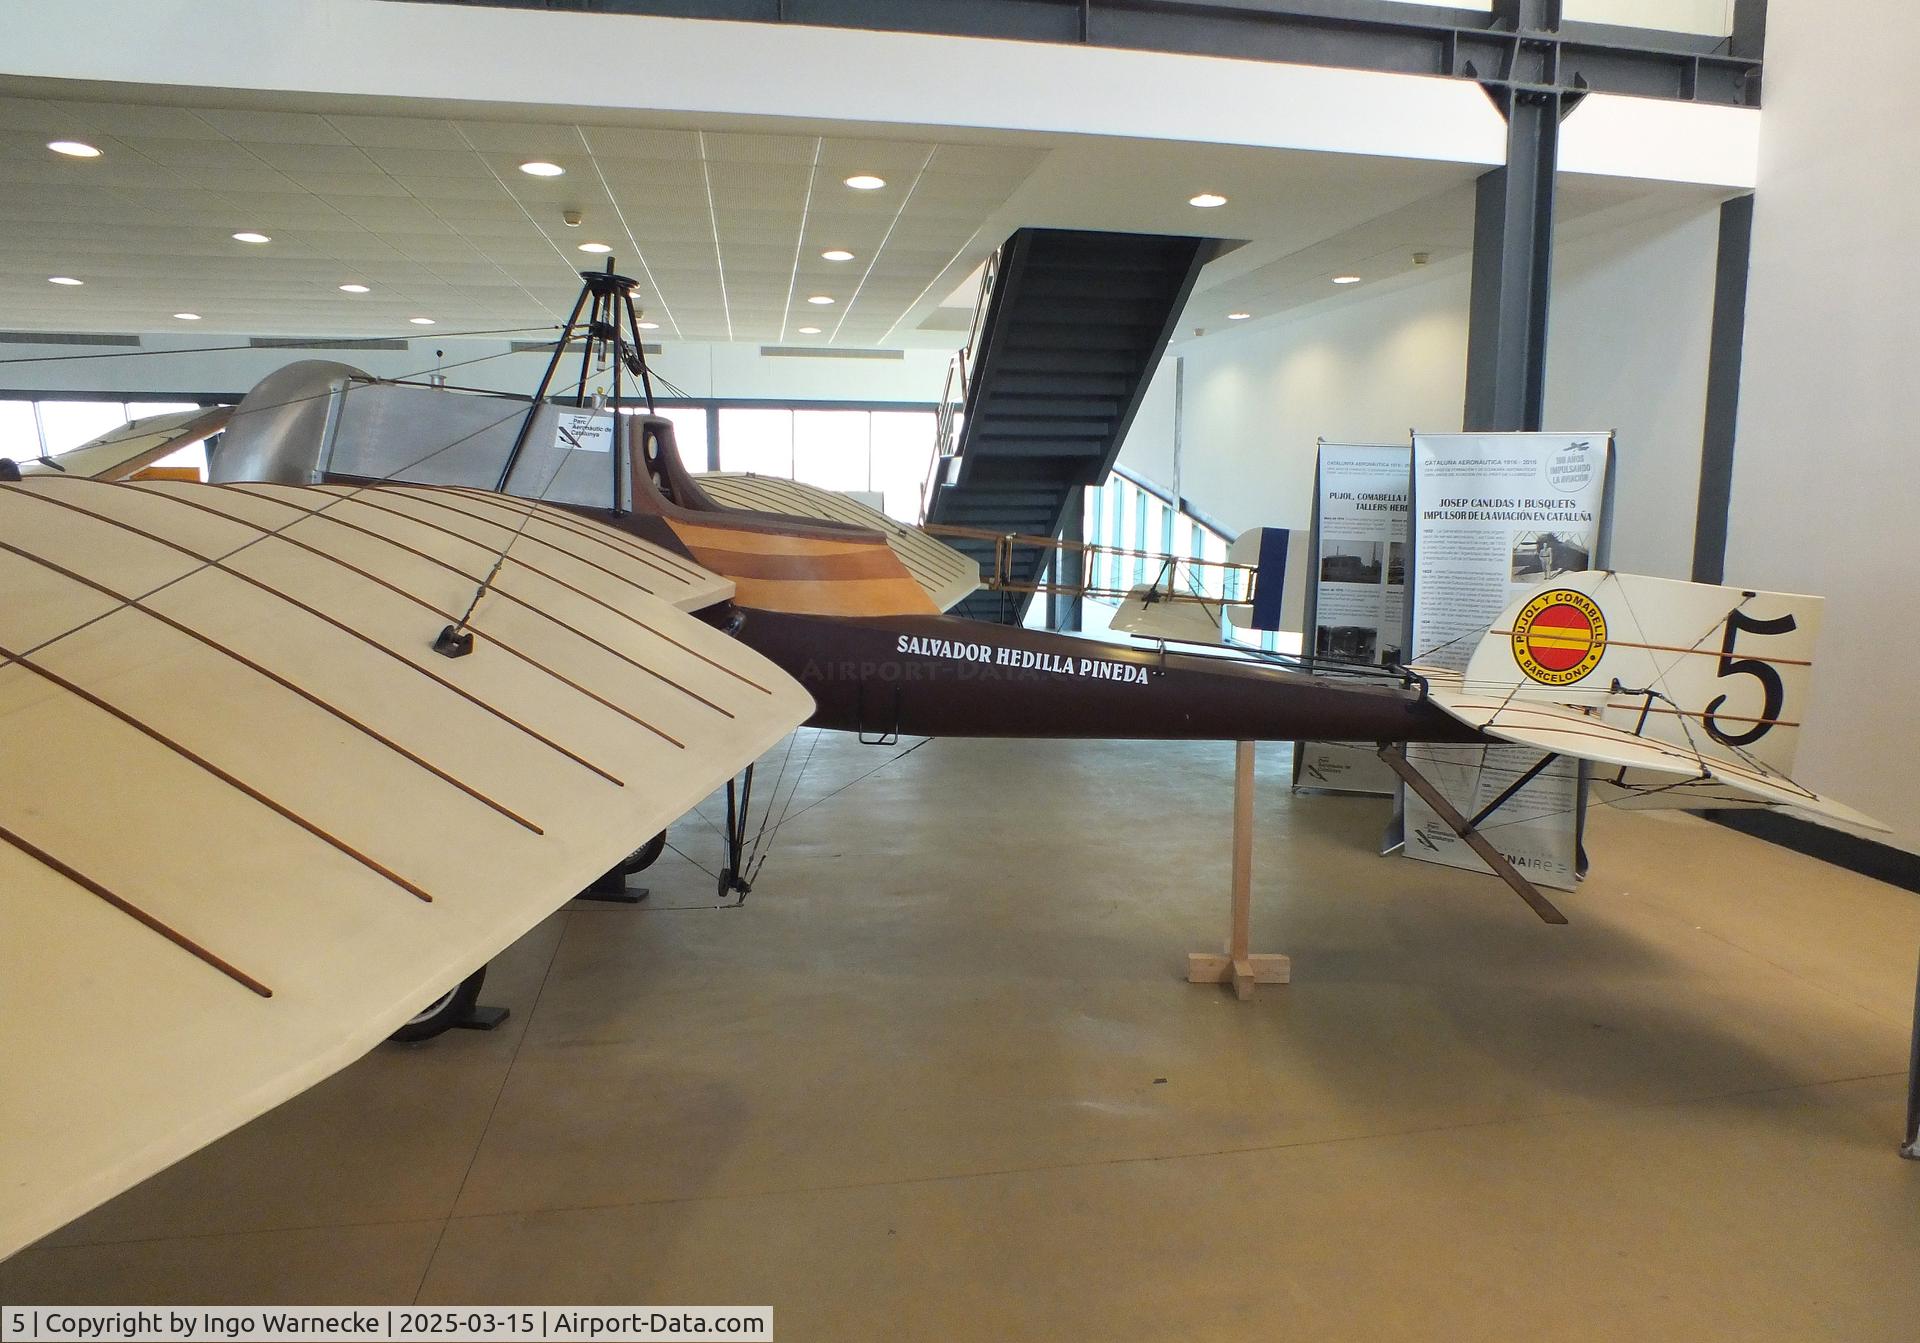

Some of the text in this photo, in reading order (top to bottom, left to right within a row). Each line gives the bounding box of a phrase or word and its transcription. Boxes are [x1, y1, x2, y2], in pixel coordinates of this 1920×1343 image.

[1357, 493, 1401, 502] COMABELLA
[1439, 498, 1468, 508] JOSEP
[1471, 498, 1514, 508] CANUDAS
[1524, 499, 1576, 509] BUSQUETS
[1356, 503, 1387, 511] TALLERS
[1424, 509, 1592, 521] IMPULSOR DE LA AVIACIÓN EN CATALUÑA
[1516, 604, 1540, 643] PUJOL
[1542, 595, 1550, 605] Y
[897, 635, 1149, 685] SALVADOR HEDILLA PINEDA
[1523, 660, 1589, 682] BARCELONA
[1703, 608, 1796, 746] 5
